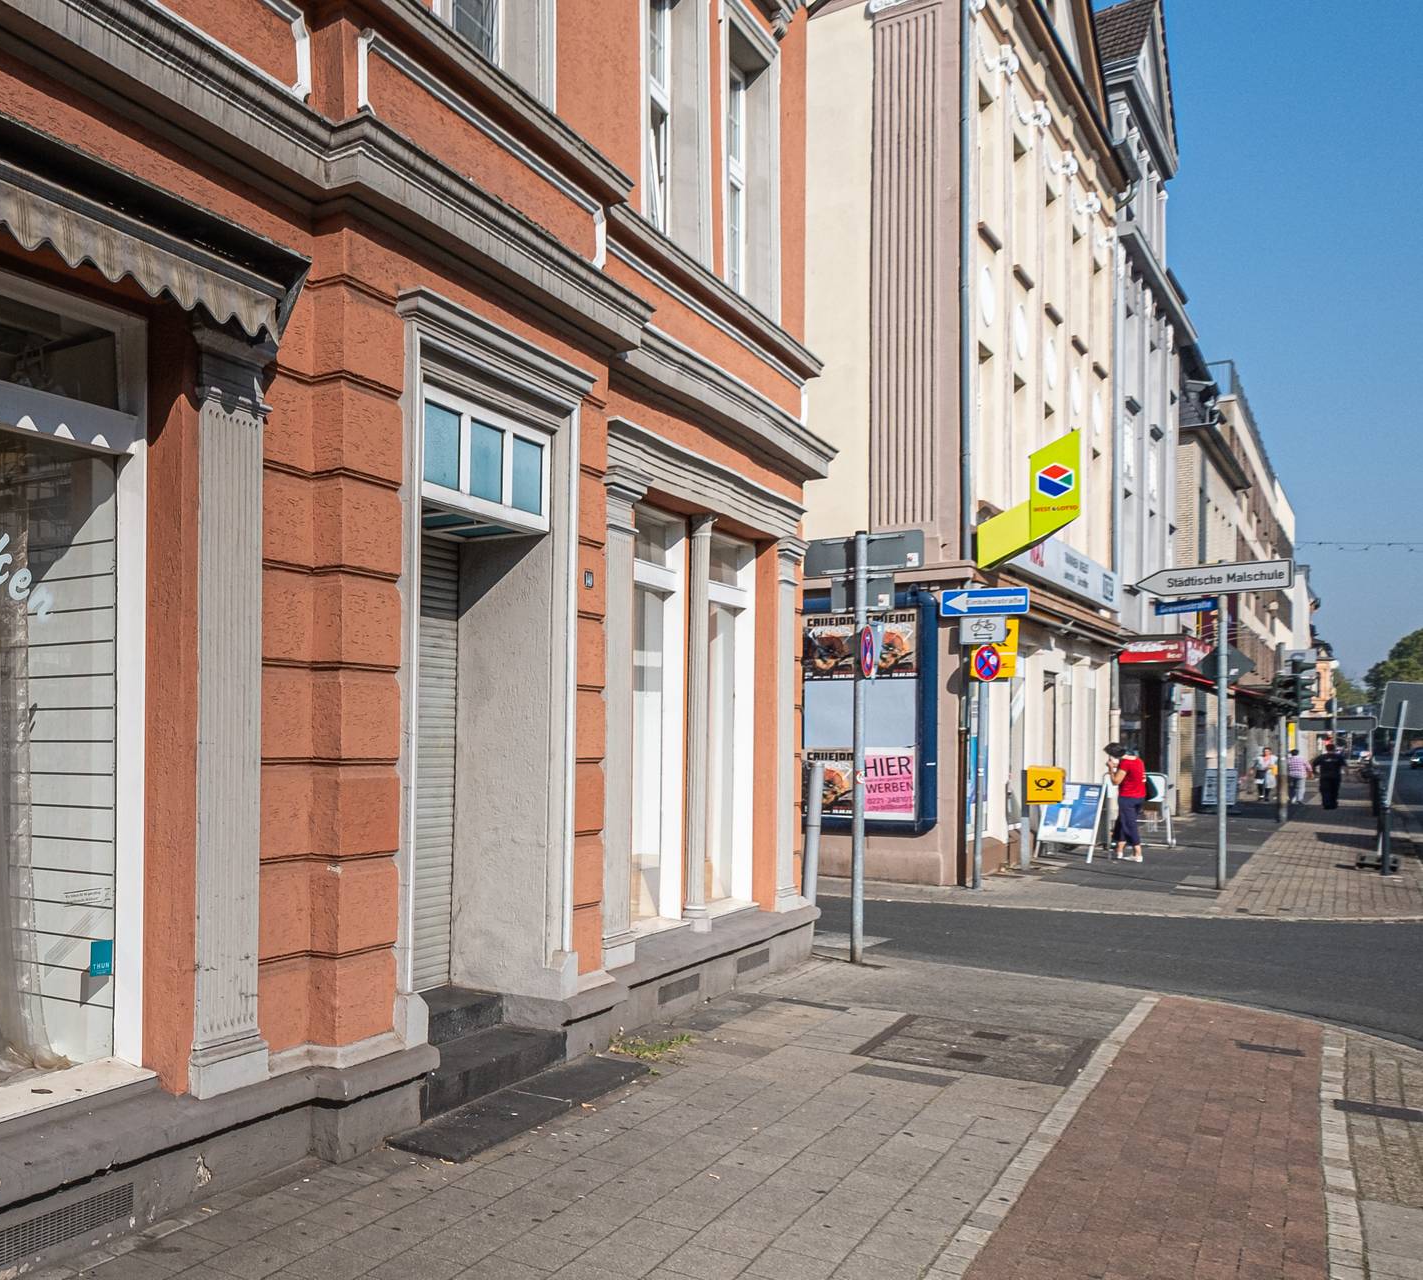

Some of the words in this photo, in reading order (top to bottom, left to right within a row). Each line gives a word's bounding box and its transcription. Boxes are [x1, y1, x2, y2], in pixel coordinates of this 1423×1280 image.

[1167, 574, 1223, 588] Städtische
[1226, 569, 1285, 583] Malschule
[864, 756, 912, 777] HIER
[866, 782, 914, 794] WERBEN
[93, 962, 110, 970] THUN
